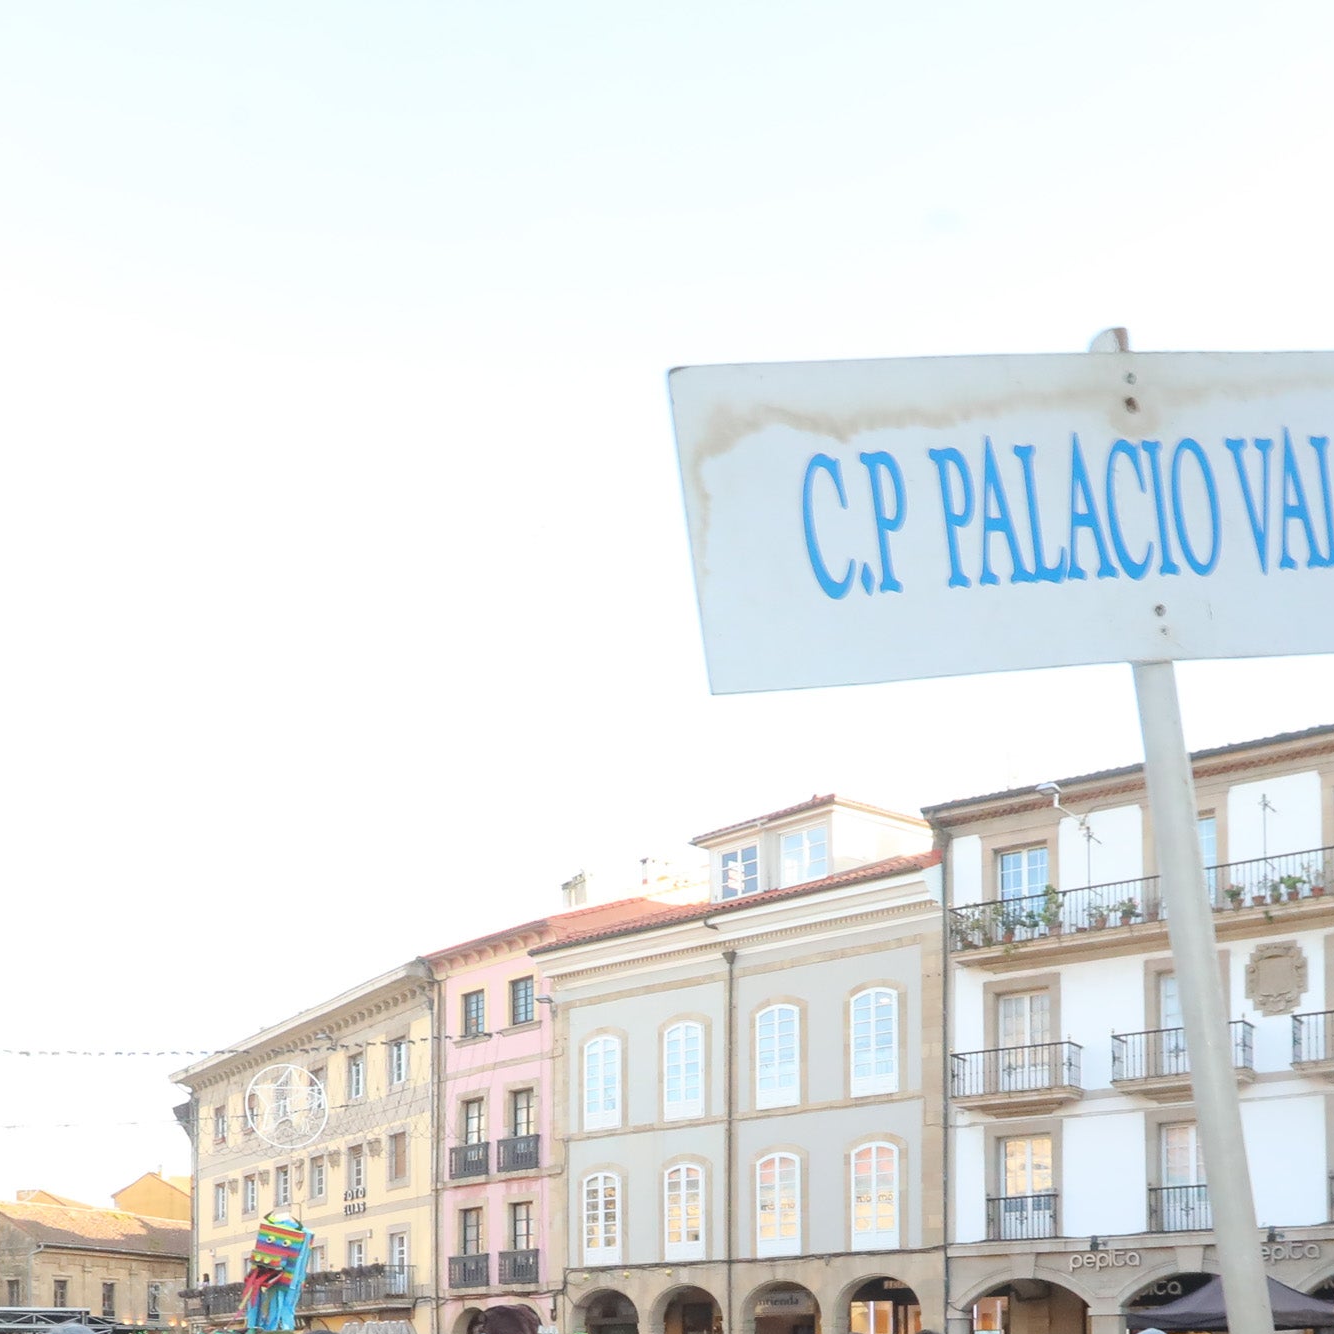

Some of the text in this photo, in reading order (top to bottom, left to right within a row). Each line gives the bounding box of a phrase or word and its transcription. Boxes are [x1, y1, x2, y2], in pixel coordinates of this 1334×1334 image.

[801, 450, 907, 601] C.P
[926, 432, 1222, 589] PALACIO
[1069, 1249, 1141, 1272] pepita
[1261, 1242, 1320, 1265] epita
